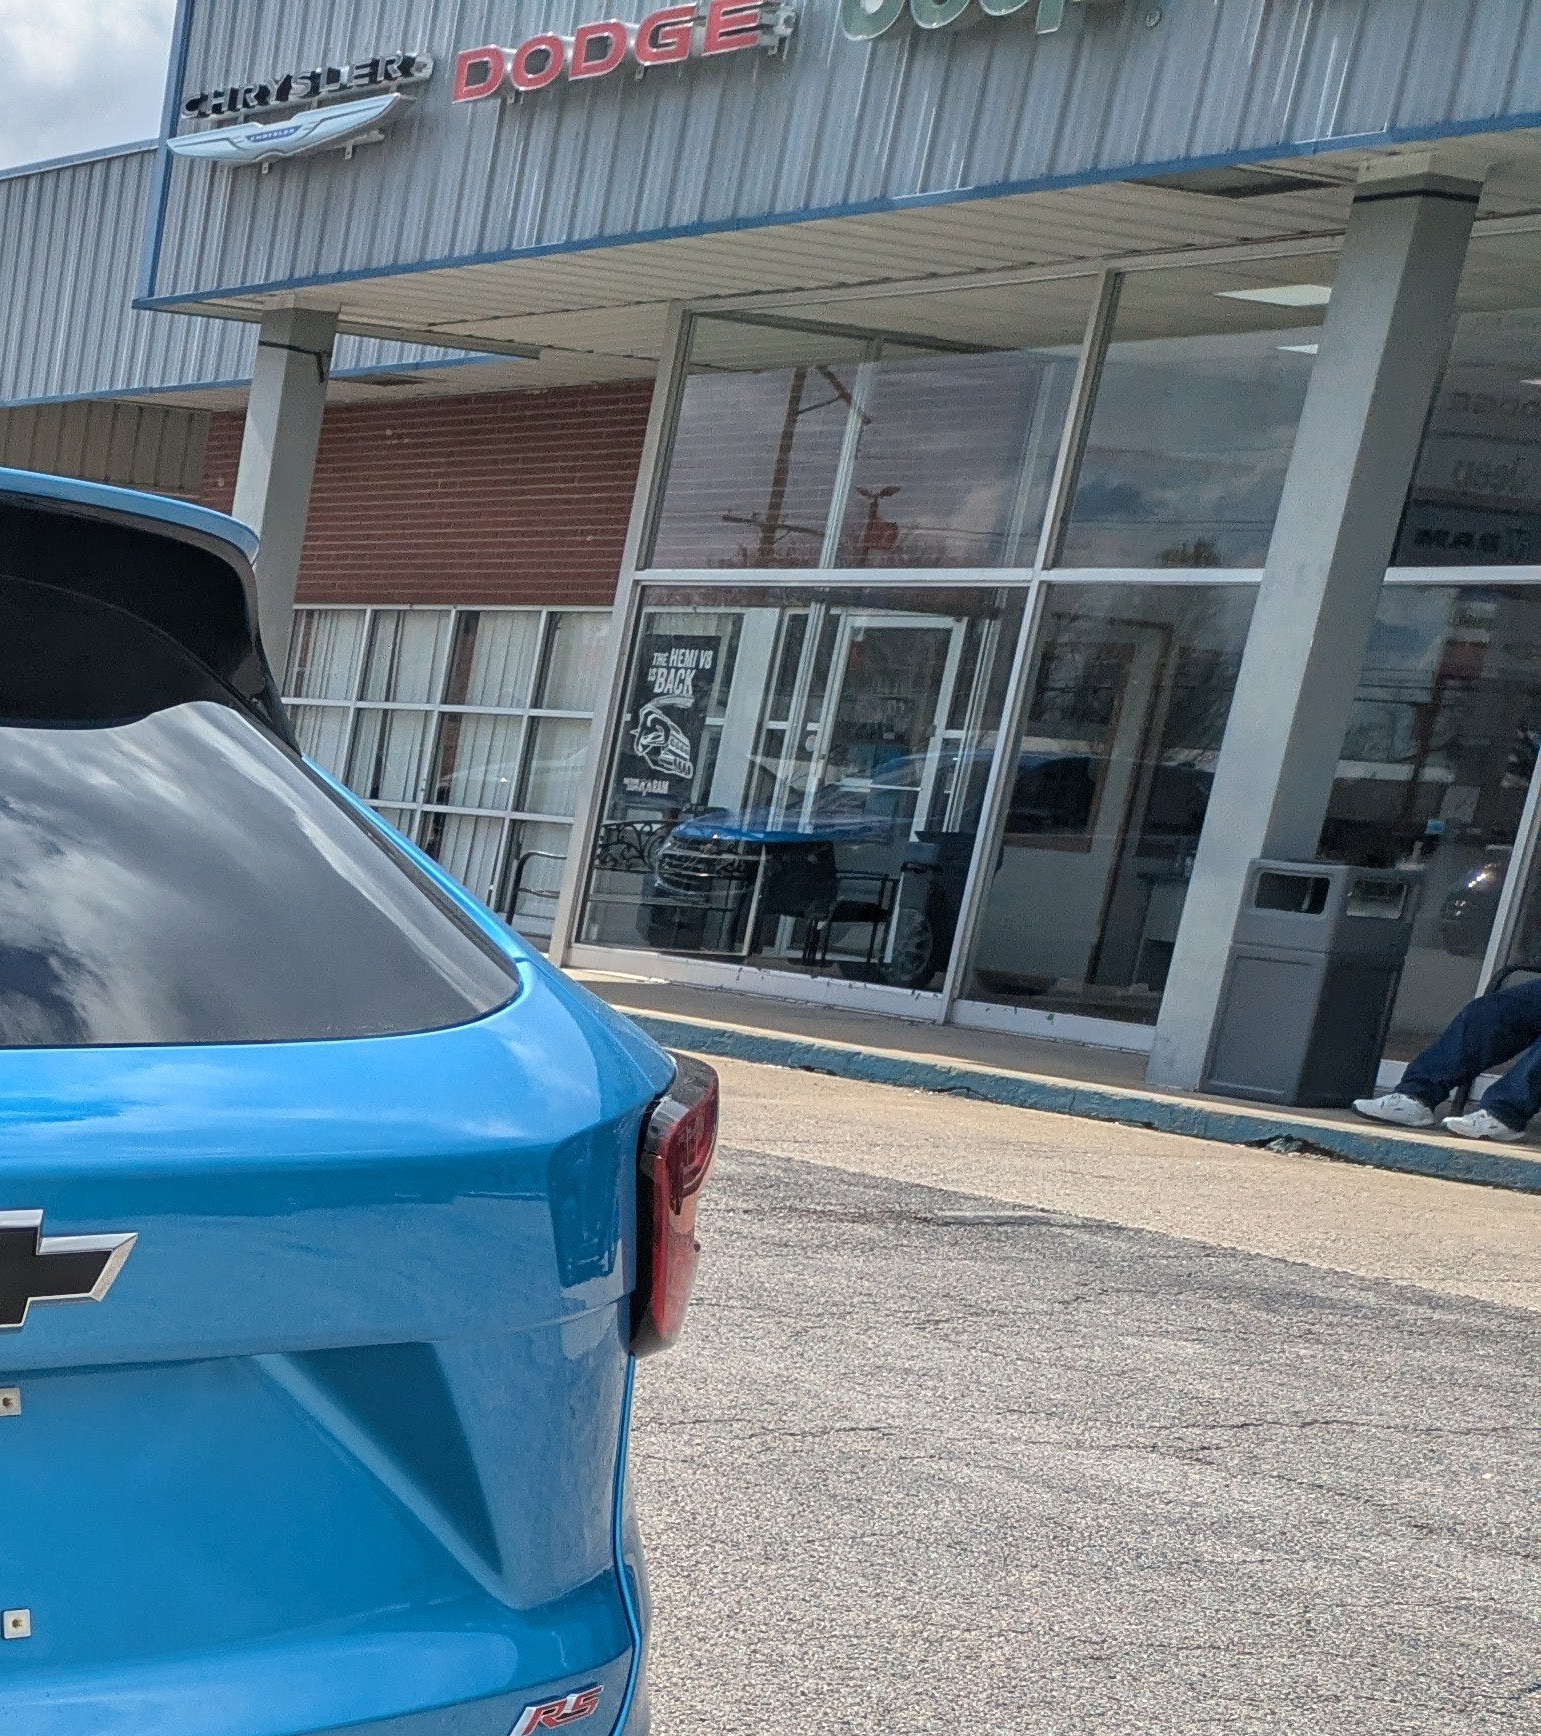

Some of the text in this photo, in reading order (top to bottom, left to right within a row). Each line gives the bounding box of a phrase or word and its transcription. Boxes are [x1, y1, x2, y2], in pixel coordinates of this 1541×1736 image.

[452, 0, 763, 103] DODGE
[181, 54, 414, 119] CHRYSLER
[647, 667, 696, 696] IS BACK
[651, 648, 714, 669] THE HEMI V8
